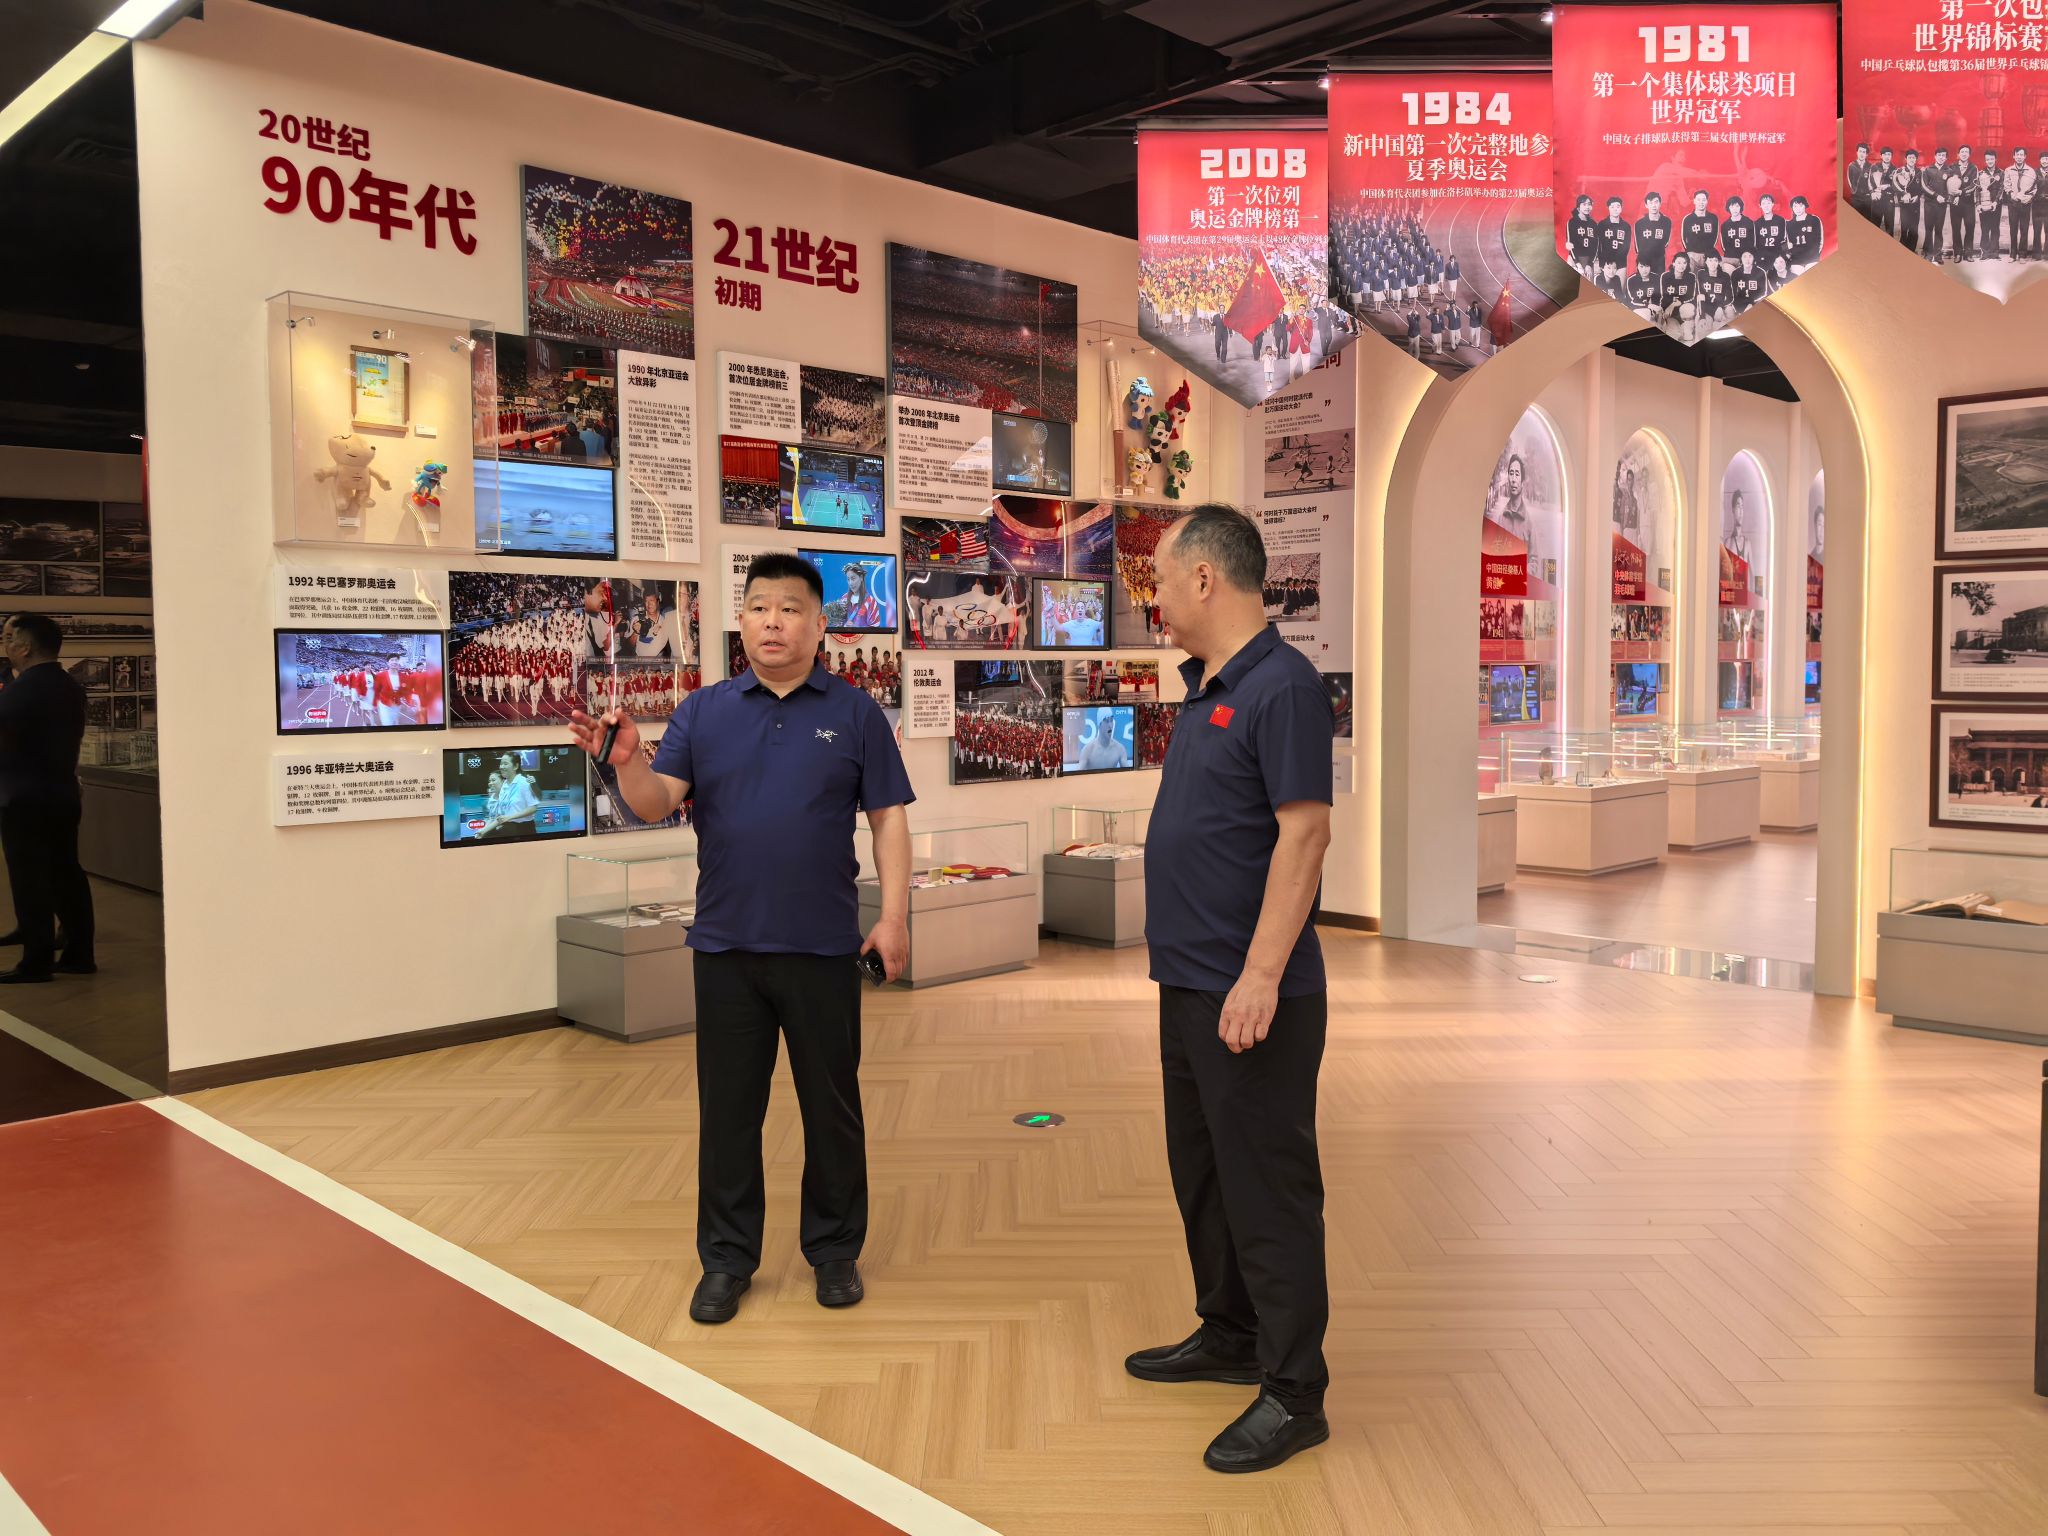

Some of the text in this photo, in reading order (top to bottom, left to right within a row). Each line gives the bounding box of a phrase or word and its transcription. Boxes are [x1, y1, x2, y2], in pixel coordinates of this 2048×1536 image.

[1939, 0, 2048, 20] 第一次包
[1638, 25, 1750, 63] 1981
[1912, 21, 2048, 53] 世界锦标赛
[1592, 71, 1796, 98] 第一个集体球类项目
[1402, 92, 1512, 126] 1984
[1650, 98, 1741, 125] 世界冠军
[259, 109, 370, 161] 20世纪
[1603, 131, 1786, 144] 中国女子排球队获得第三届女排世界杯冠军
[1343, 132, 1553, 157] 新中国第一次完整地参
[1200, 148, 1307, 179] 2008
[1406, 158, 1508, 181] 夏季奥运会
[1208, 185, 1300, 206] 第一次位列
[261, 156, 478, 256] 90年代
[1190, 208, 1319, 229] 奥运金牌榜第一
[1605, 228, 1625, 240] 中国
[1643, 228, 1664, 240] 中国
[1691, 223, 1712, 234] 中国
[1728, 227, 1747, 239] 中国
[1760, 226, 1778, 237] 中国
[1583, 238, 1589, 247] 8
[1734, 239, 1740, 248] 6
[1764, 237, 1775, 247] 12
[1796, 235, 1806, 245] 11
[713, 218, 860, 294] 21世纪
[1704, 281, 1722, 293] 中国
[1738, 279, 1757, 290] 中国
[715, 276, 762, 312] 初期
[729, 363, 745, 373] 2000
[1311, 352, 1341, 370] 问
[628, 364, 689, 381] 1990 年北京亚运会
[628, 376, 657, 388] 大放异彩
[911, 408, 926, 417] 2008
[927, 410, 960, 423] 年北京奥运会
[733, 553, 749, 563] 2004
[289, 577, 396, 589] 1992 年巴塞罗那奥运会
[913, 668, 935, 677] 2012 年
[913, 677, 942, 687] 伦敦奥运会
[286, 760, 395, 776] 1996 年亚特兰大奥运会
